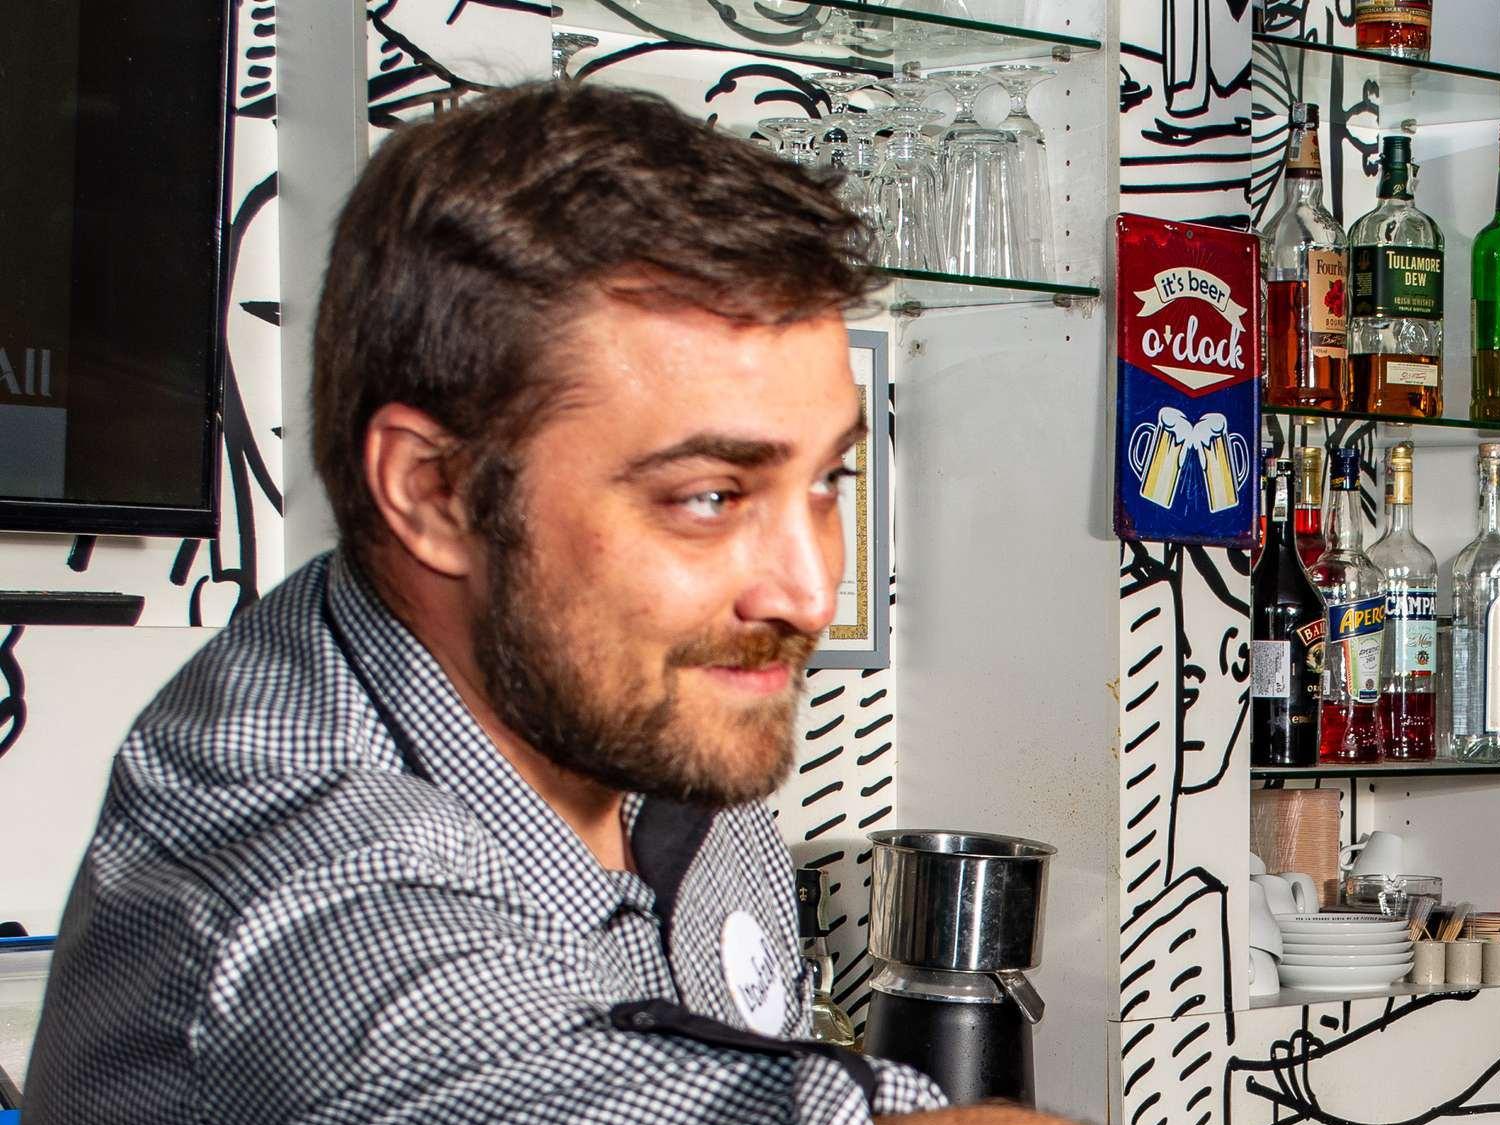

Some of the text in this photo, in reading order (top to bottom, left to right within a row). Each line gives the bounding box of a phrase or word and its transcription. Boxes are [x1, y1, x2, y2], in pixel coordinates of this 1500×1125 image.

[1386, 250, 1441, 273] TULLAMORE
[1161, 270, 1226, 304] it's beer
[1405, 271, 1427, 287] DEW
[0, 347, 51, 397] All
